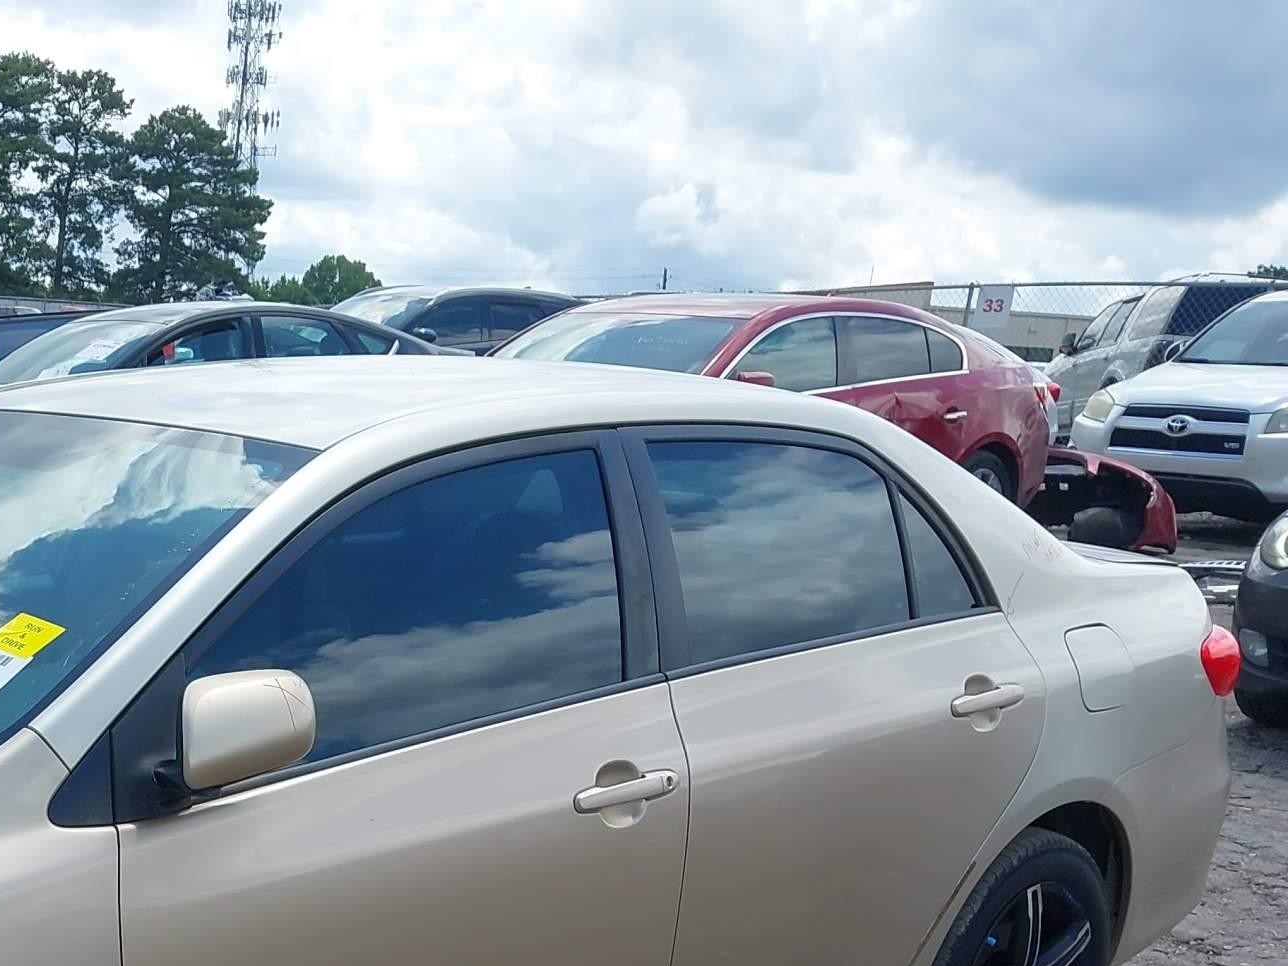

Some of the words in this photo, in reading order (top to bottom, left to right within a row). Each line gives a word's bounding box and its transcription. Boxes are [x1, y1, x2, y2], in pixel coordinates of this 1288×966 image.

[983, 298, 1004, 313] 33
[23, 622, 44, 634] RUN
[18, 632, 28, 640] &
[0, 637, 26, 651] DRIVE
